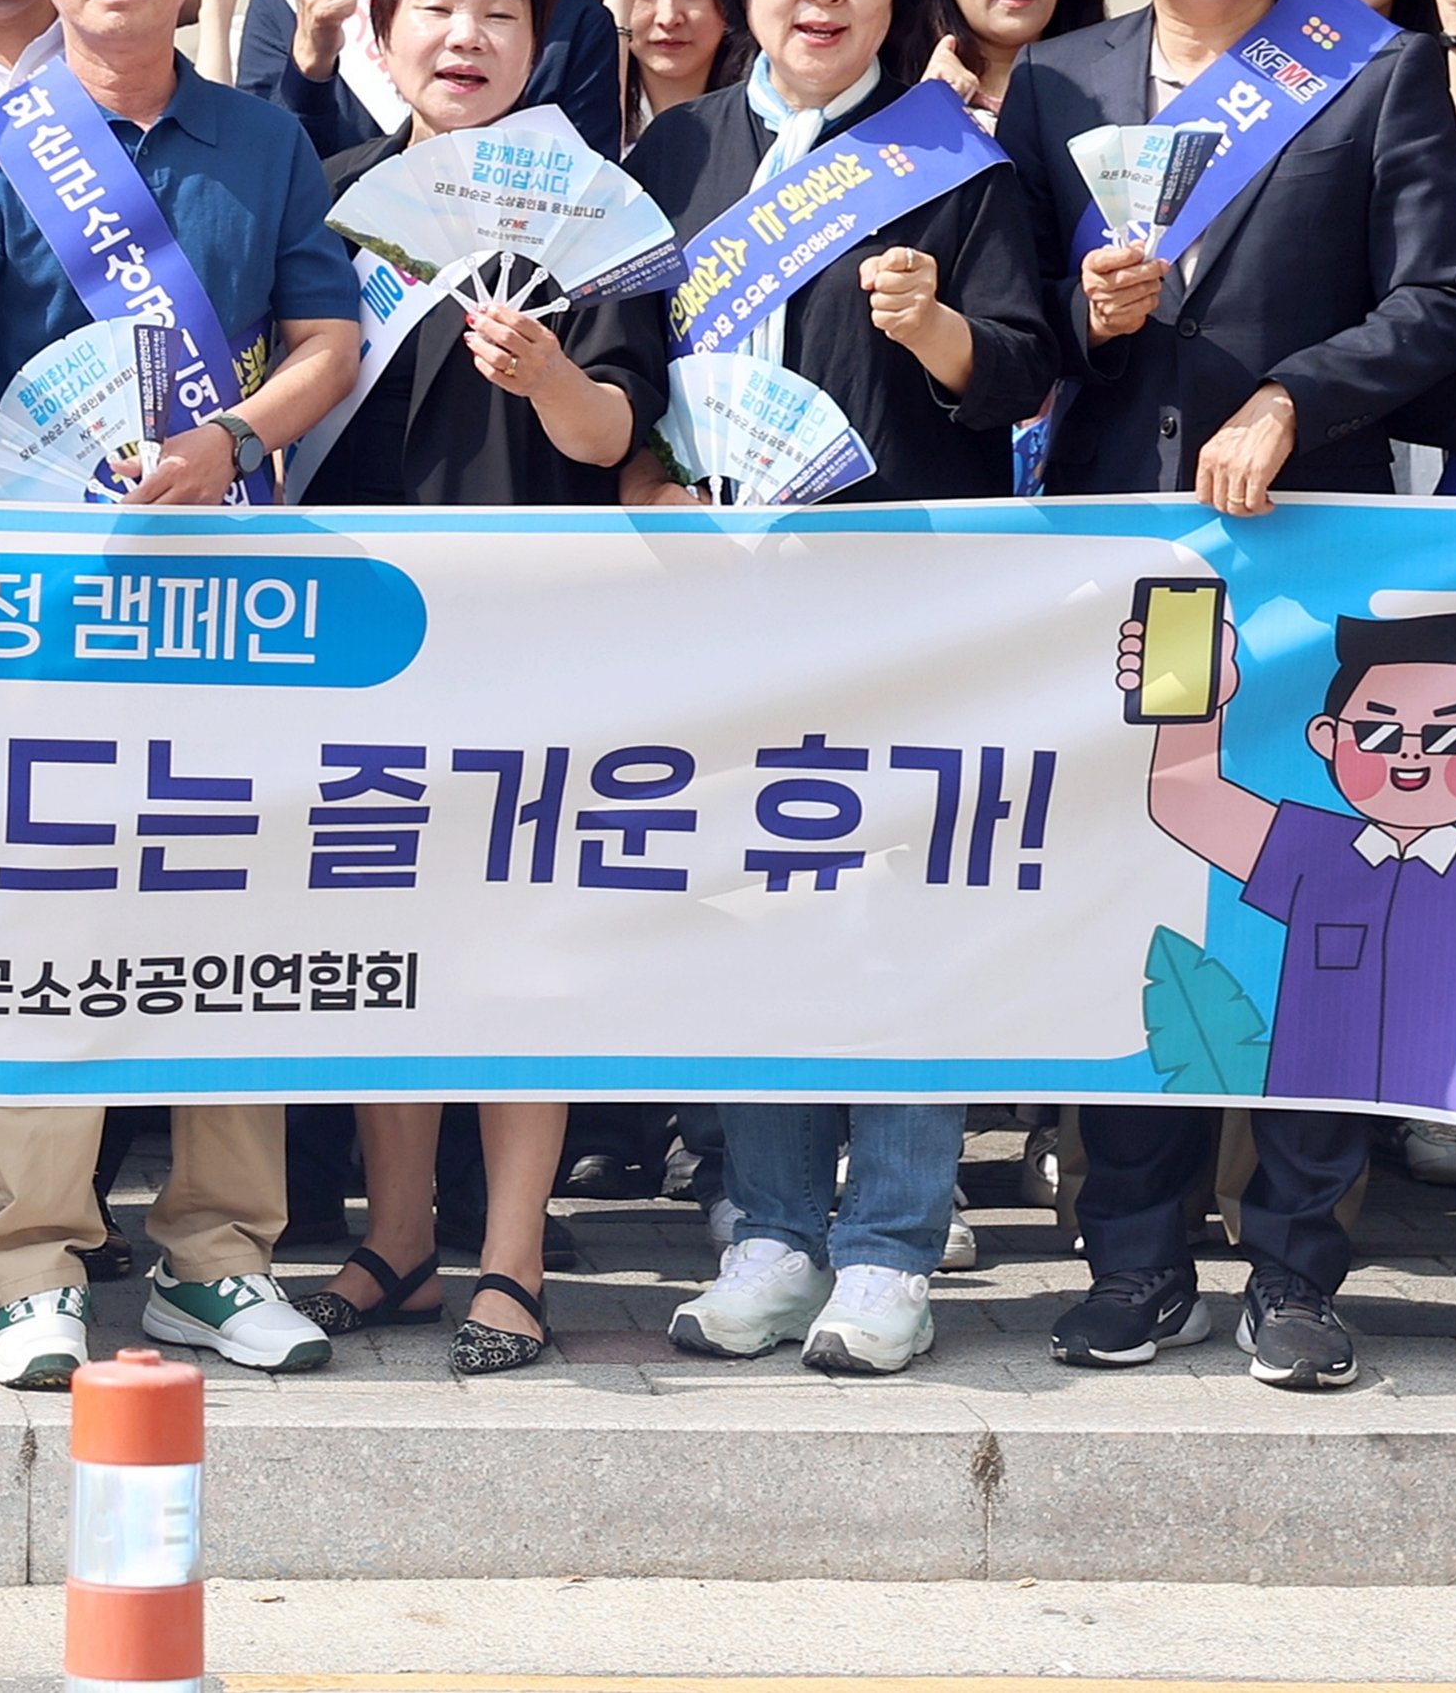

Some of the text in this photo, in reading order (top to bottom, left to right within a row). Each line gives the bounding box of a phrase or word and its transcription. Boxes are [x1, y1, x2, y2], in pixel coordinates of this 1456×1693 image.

[1241, 38, 1328, 103] KFME
[471, 161, 572, 196] 같이삽시다
[476, 140, 575, 173] 함께합시다
[668, 151, 874, 343] 성장하는 소상공인
[777, 211, 858, 280] 소상공인이
[730, 273, 782, 321] 살아야
[73, 575, 318, 664] 캠페인
[307, 742, 699, 893] 즐거운
[743, 732, 1058, 893] 휴가!
